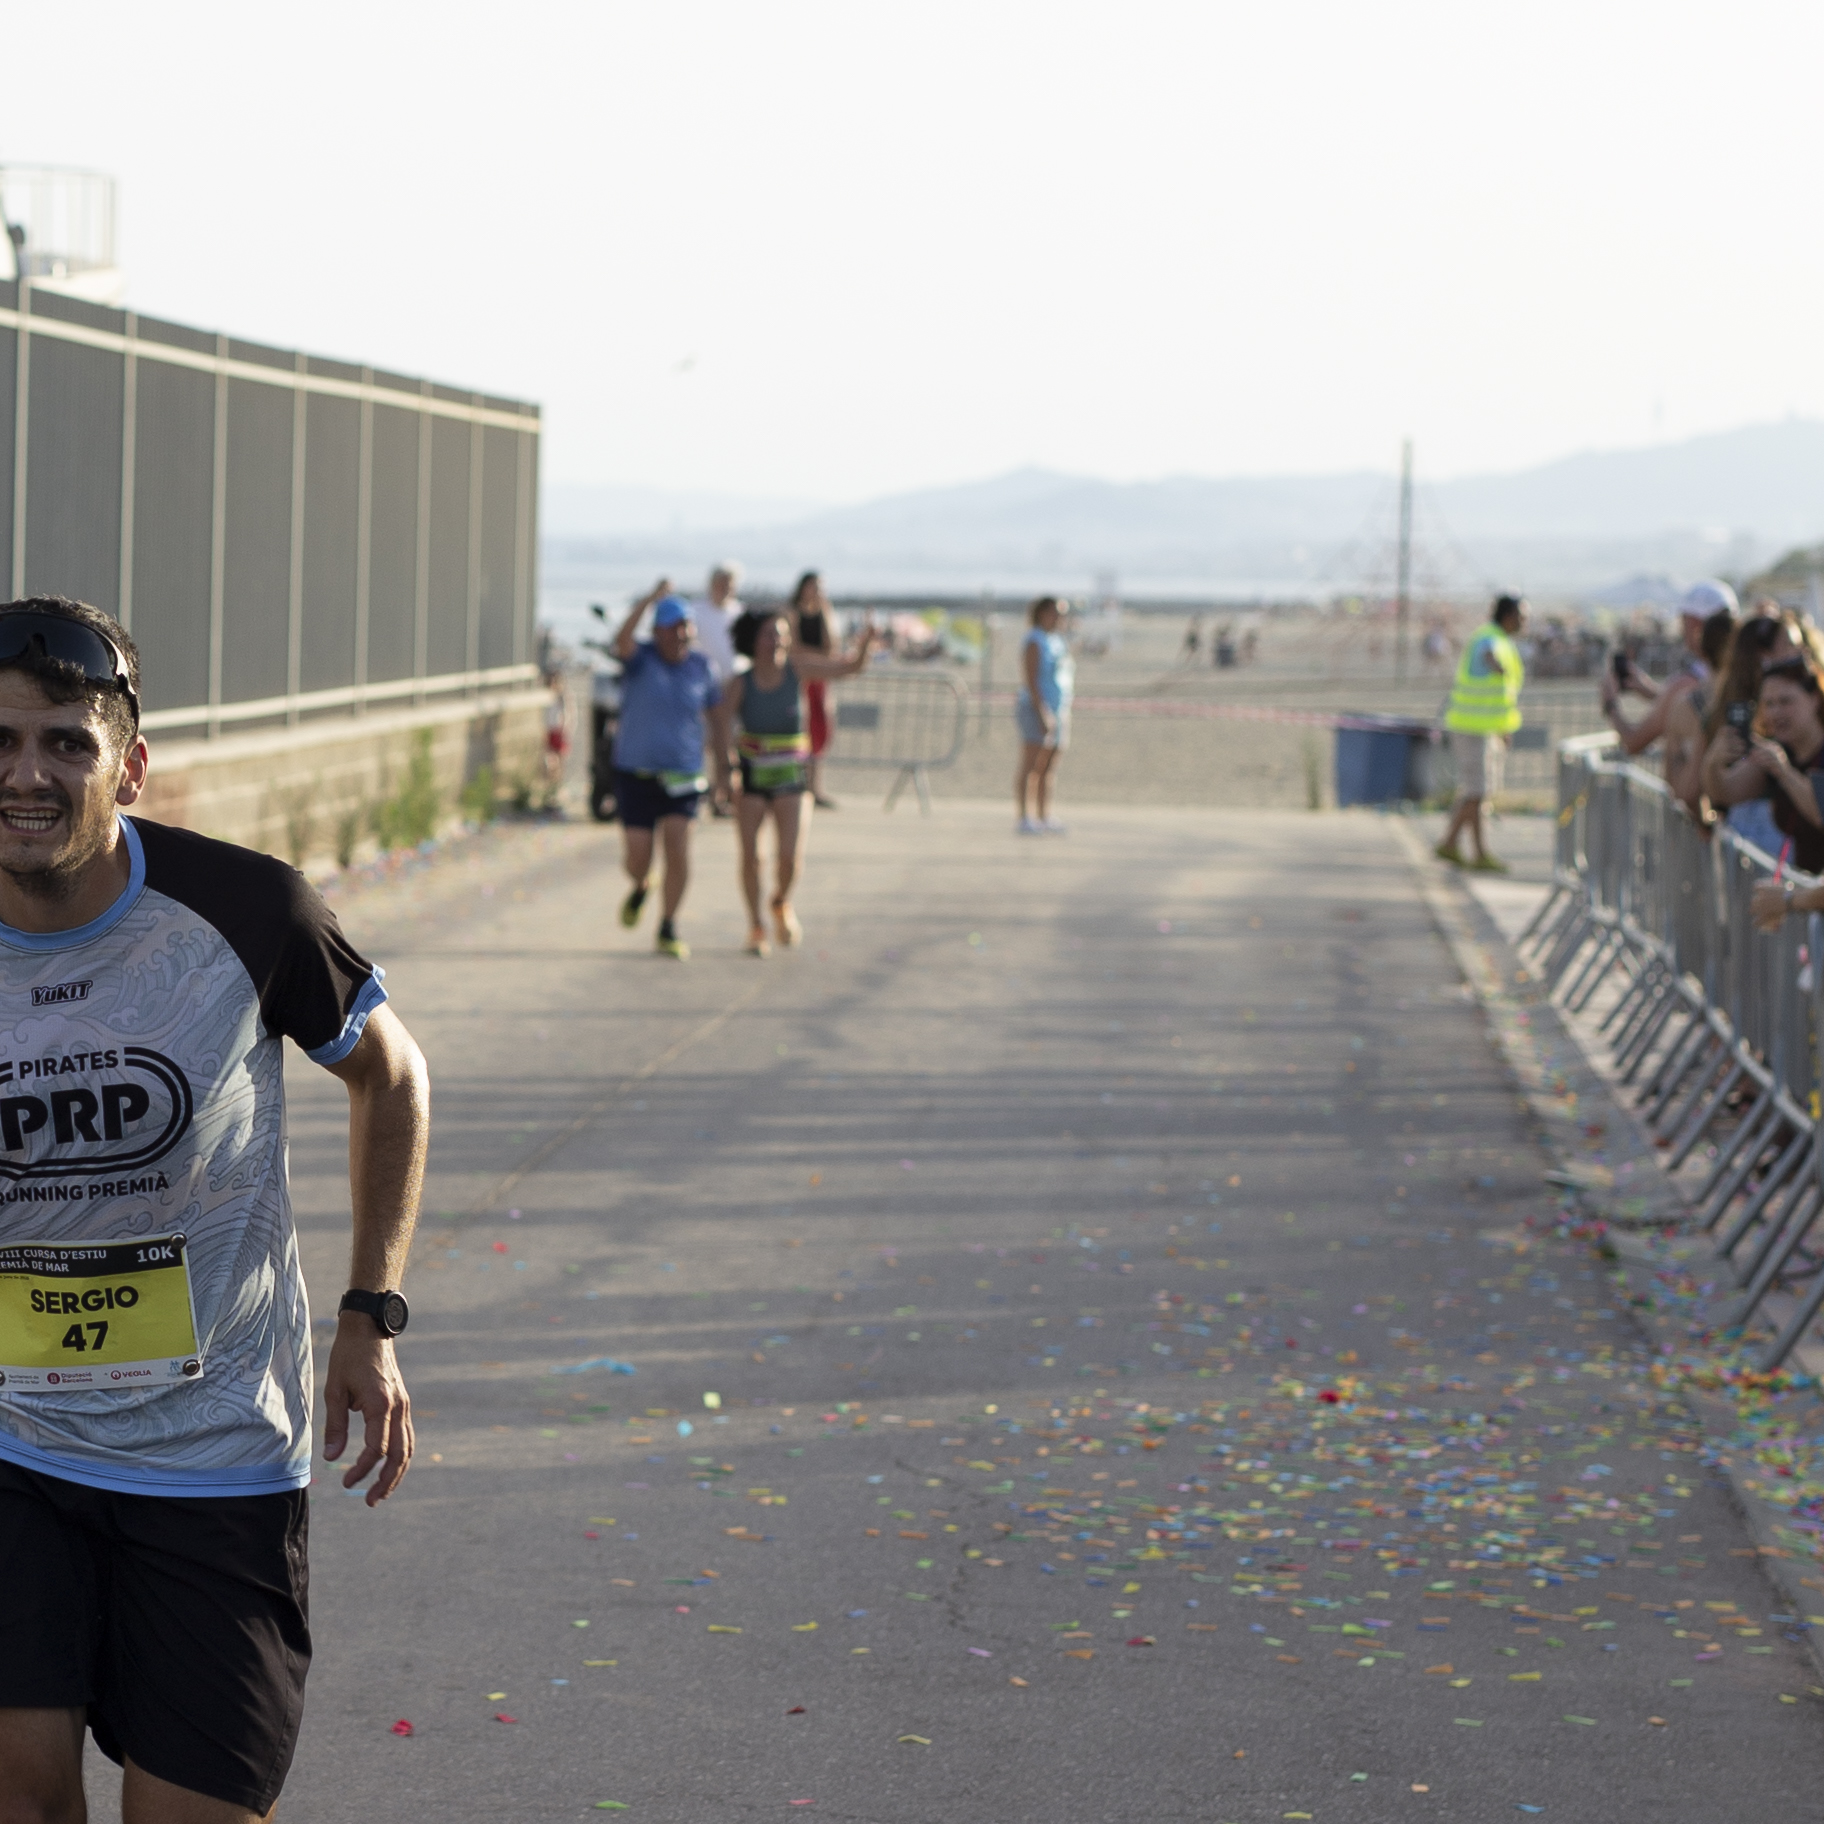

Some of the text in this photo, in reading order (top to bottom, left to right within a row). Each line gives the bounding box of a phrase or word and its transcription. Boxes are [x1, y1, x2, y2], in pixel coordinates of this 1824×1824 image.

[18, 1049, 119, 1080] PIRATES
[0, 1083, 150, 1152] PRP
[88, 1171, 170, 1200] PREMIÀ
[23, 1249, 57, 1260] CURSA
[60, 1249, 107, 1260] D'ESTIU
[31, 1261, 44, 1271] DE
[45, 1262, 70, 1273] MAR
[136, 1245, 175, 1263] 10K
[30, 1285, 139, 1314] SERGIO
[61, 1321, 109, 1352] 47
